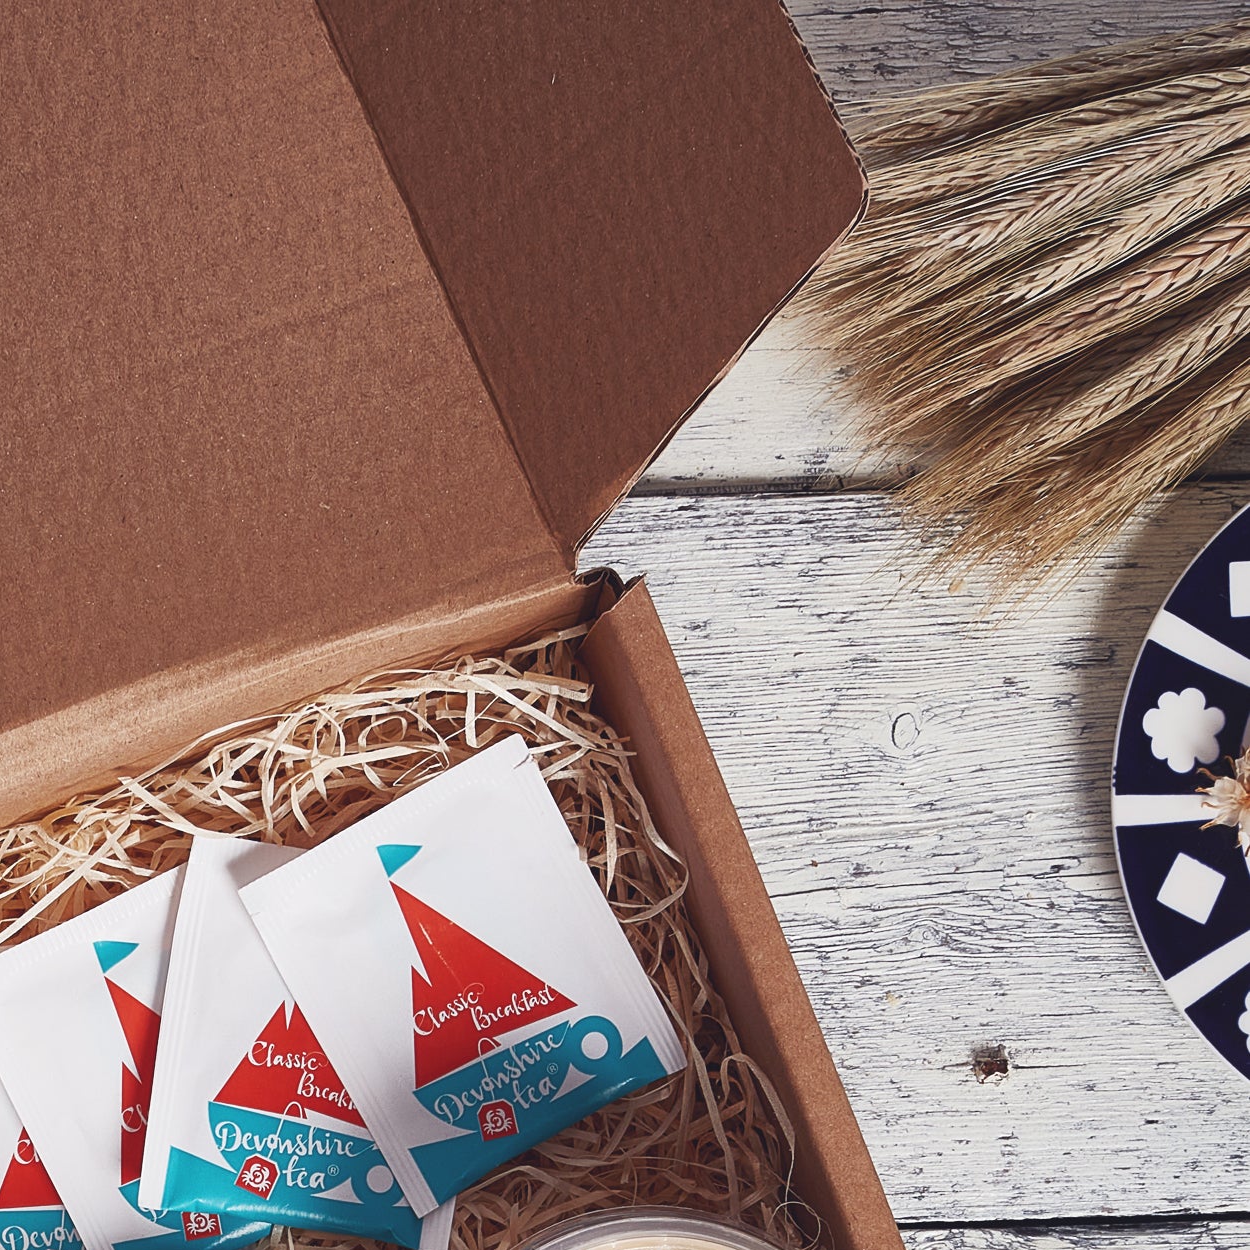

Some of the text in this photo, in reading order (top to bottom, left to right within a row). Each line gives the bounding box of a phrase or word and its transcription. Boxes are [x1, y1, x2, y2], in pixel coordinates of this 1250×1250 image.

[413, 982, 485, 1036] Classic
[470, 984, 558, 1031] Breakfast
[247, 1041, 329, 1070] Classic
[434, 1021, 570, 1126] Devonshire
[297, 1071, 357, 1110] Break
[215, 1121, 376, 1158] Devonshire
